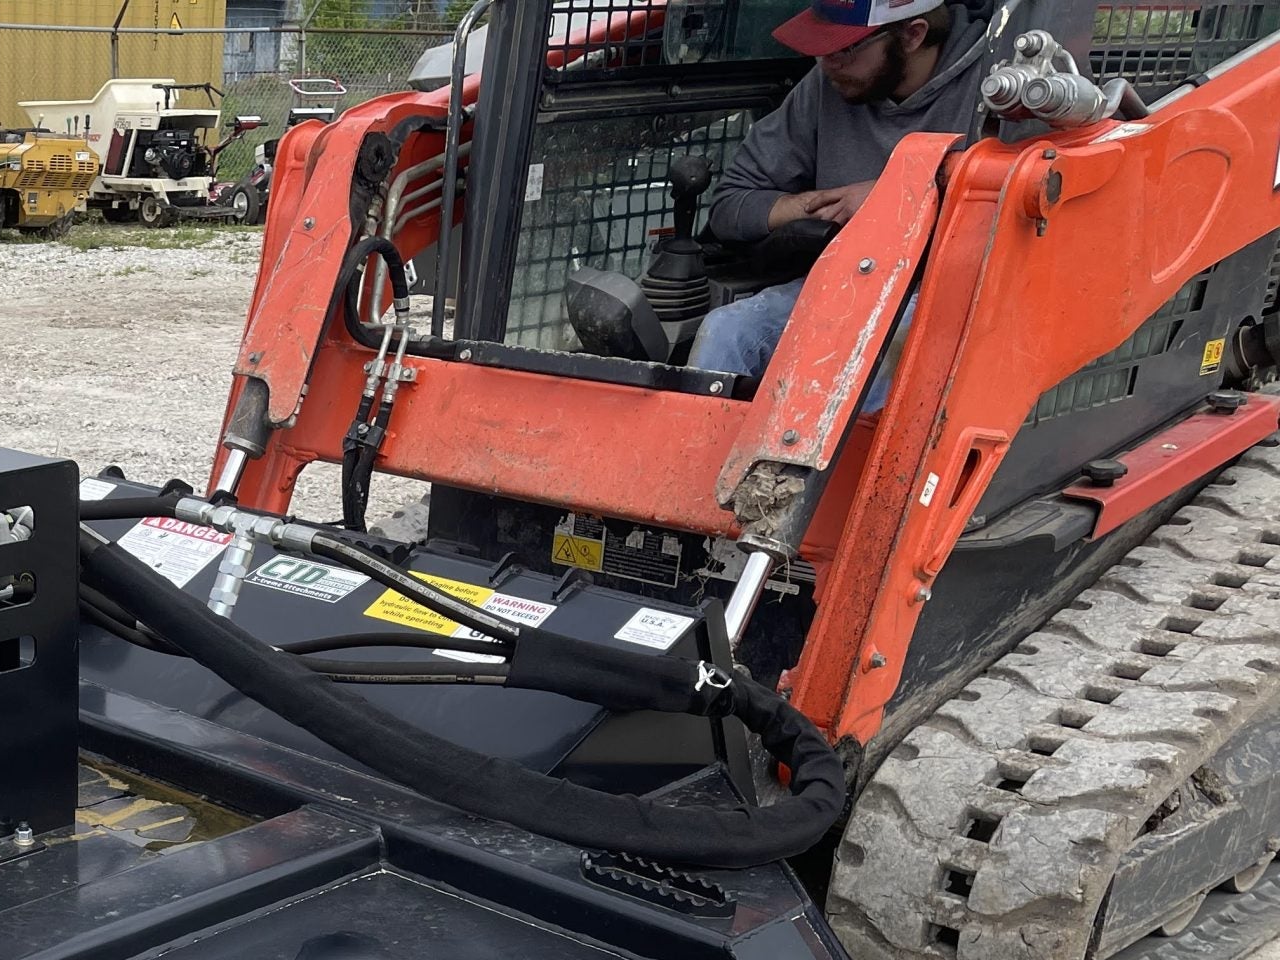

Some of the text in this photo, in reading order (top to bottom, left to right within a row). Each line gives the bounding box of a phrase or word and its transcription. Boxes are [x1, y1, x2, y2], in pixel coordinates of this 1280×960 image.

[164, 517, 229, 544] DANGER
[260, 560, 330, 585] CID
[283, 583, 332, 599] Attachments
[454, 586, 479, 596] before
[379, 600, 412, 612] hydraulic
[493, 597, 546, 614] WARNING
[383, 609, 404, 619] while
[405, 615, 444, 629] operating
[511, 610, 540, 621] EXCEED
